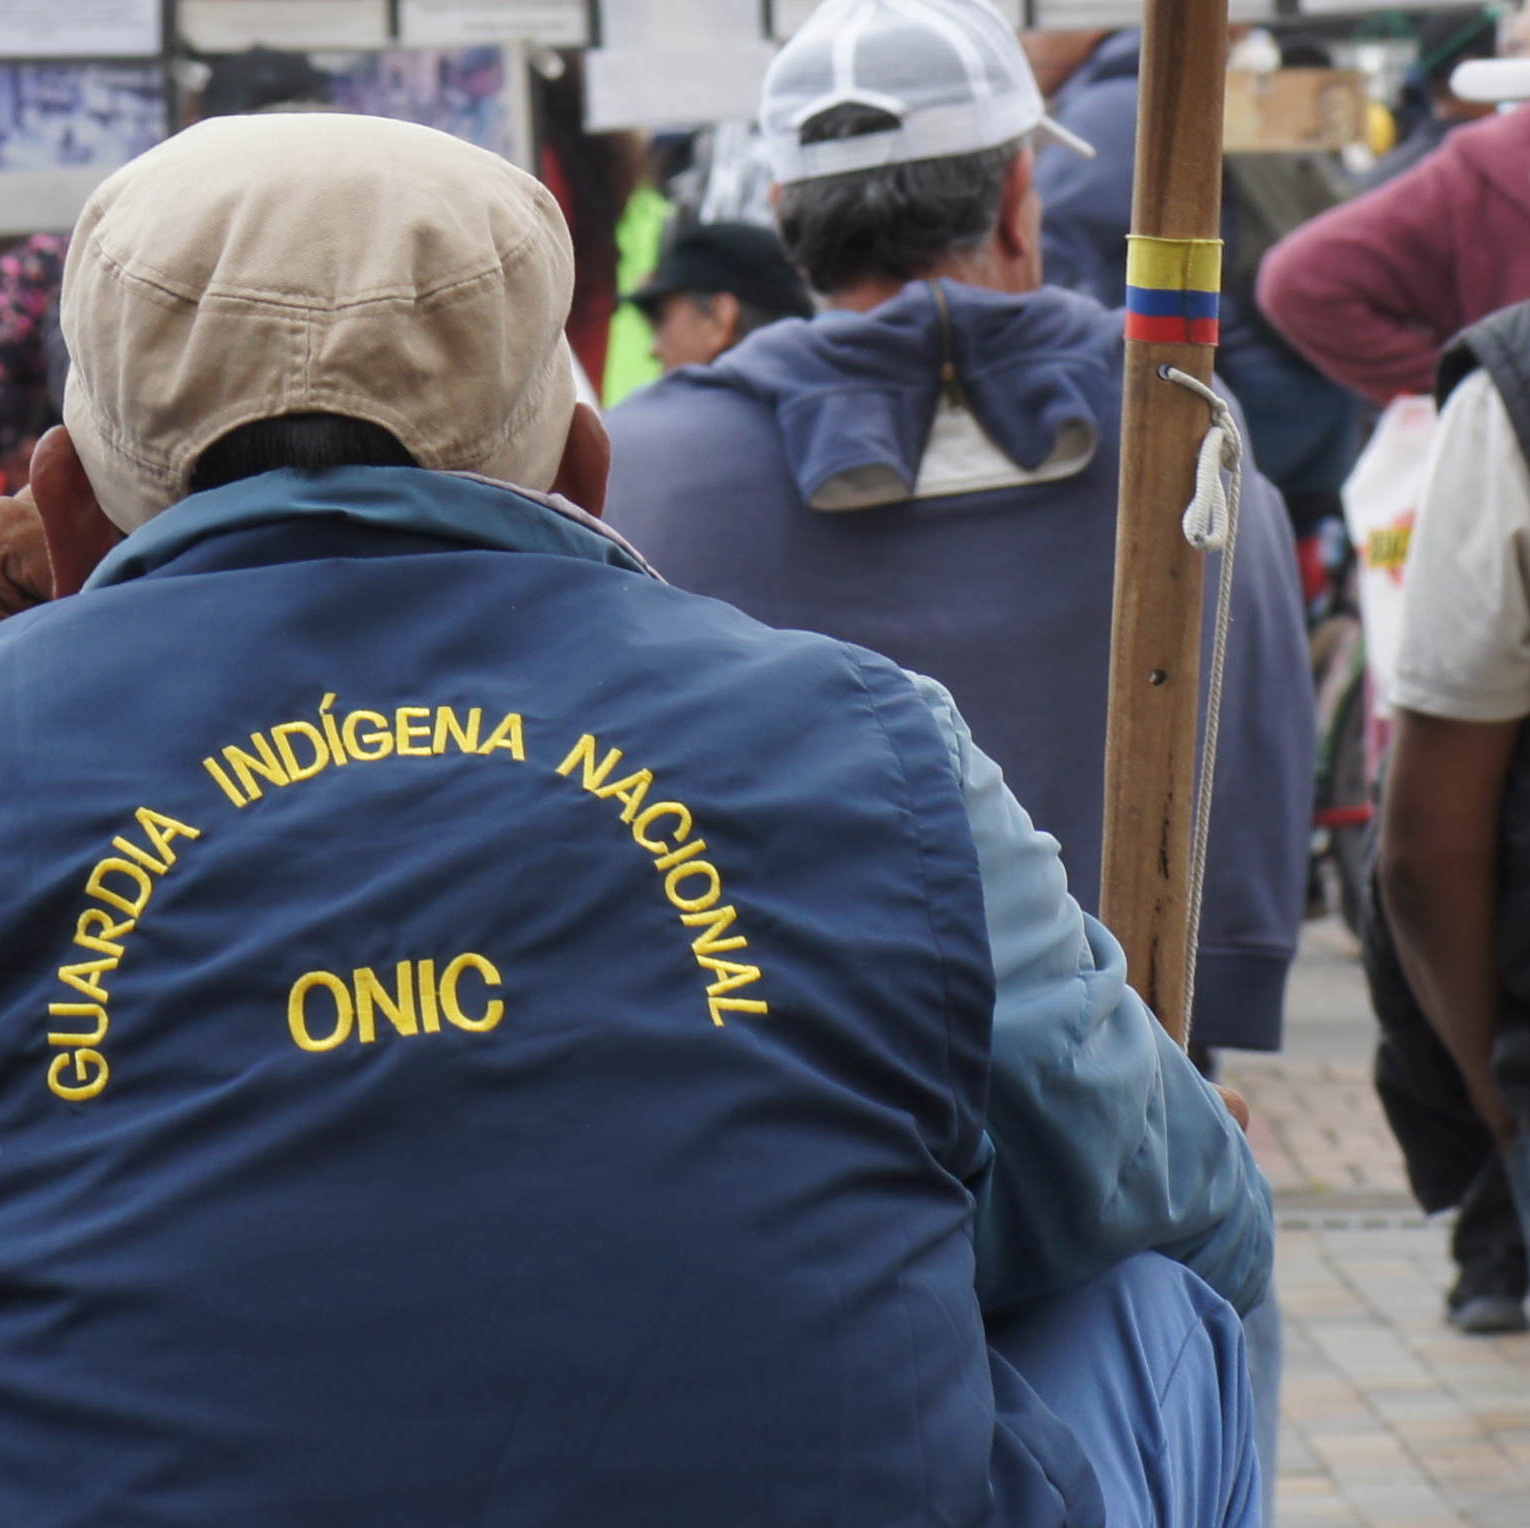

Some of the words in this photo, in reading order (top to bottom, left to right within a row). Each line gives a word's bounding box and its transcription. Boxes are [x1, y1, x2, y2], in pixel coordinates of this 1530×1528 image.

[47, 806, 201, 1103] GUARDIA
[202, 692, 527, 809] INDÍGENA
[555, 733, 770, 1028] NACIONAL
[287, 951, 506, 1053] ONIC
